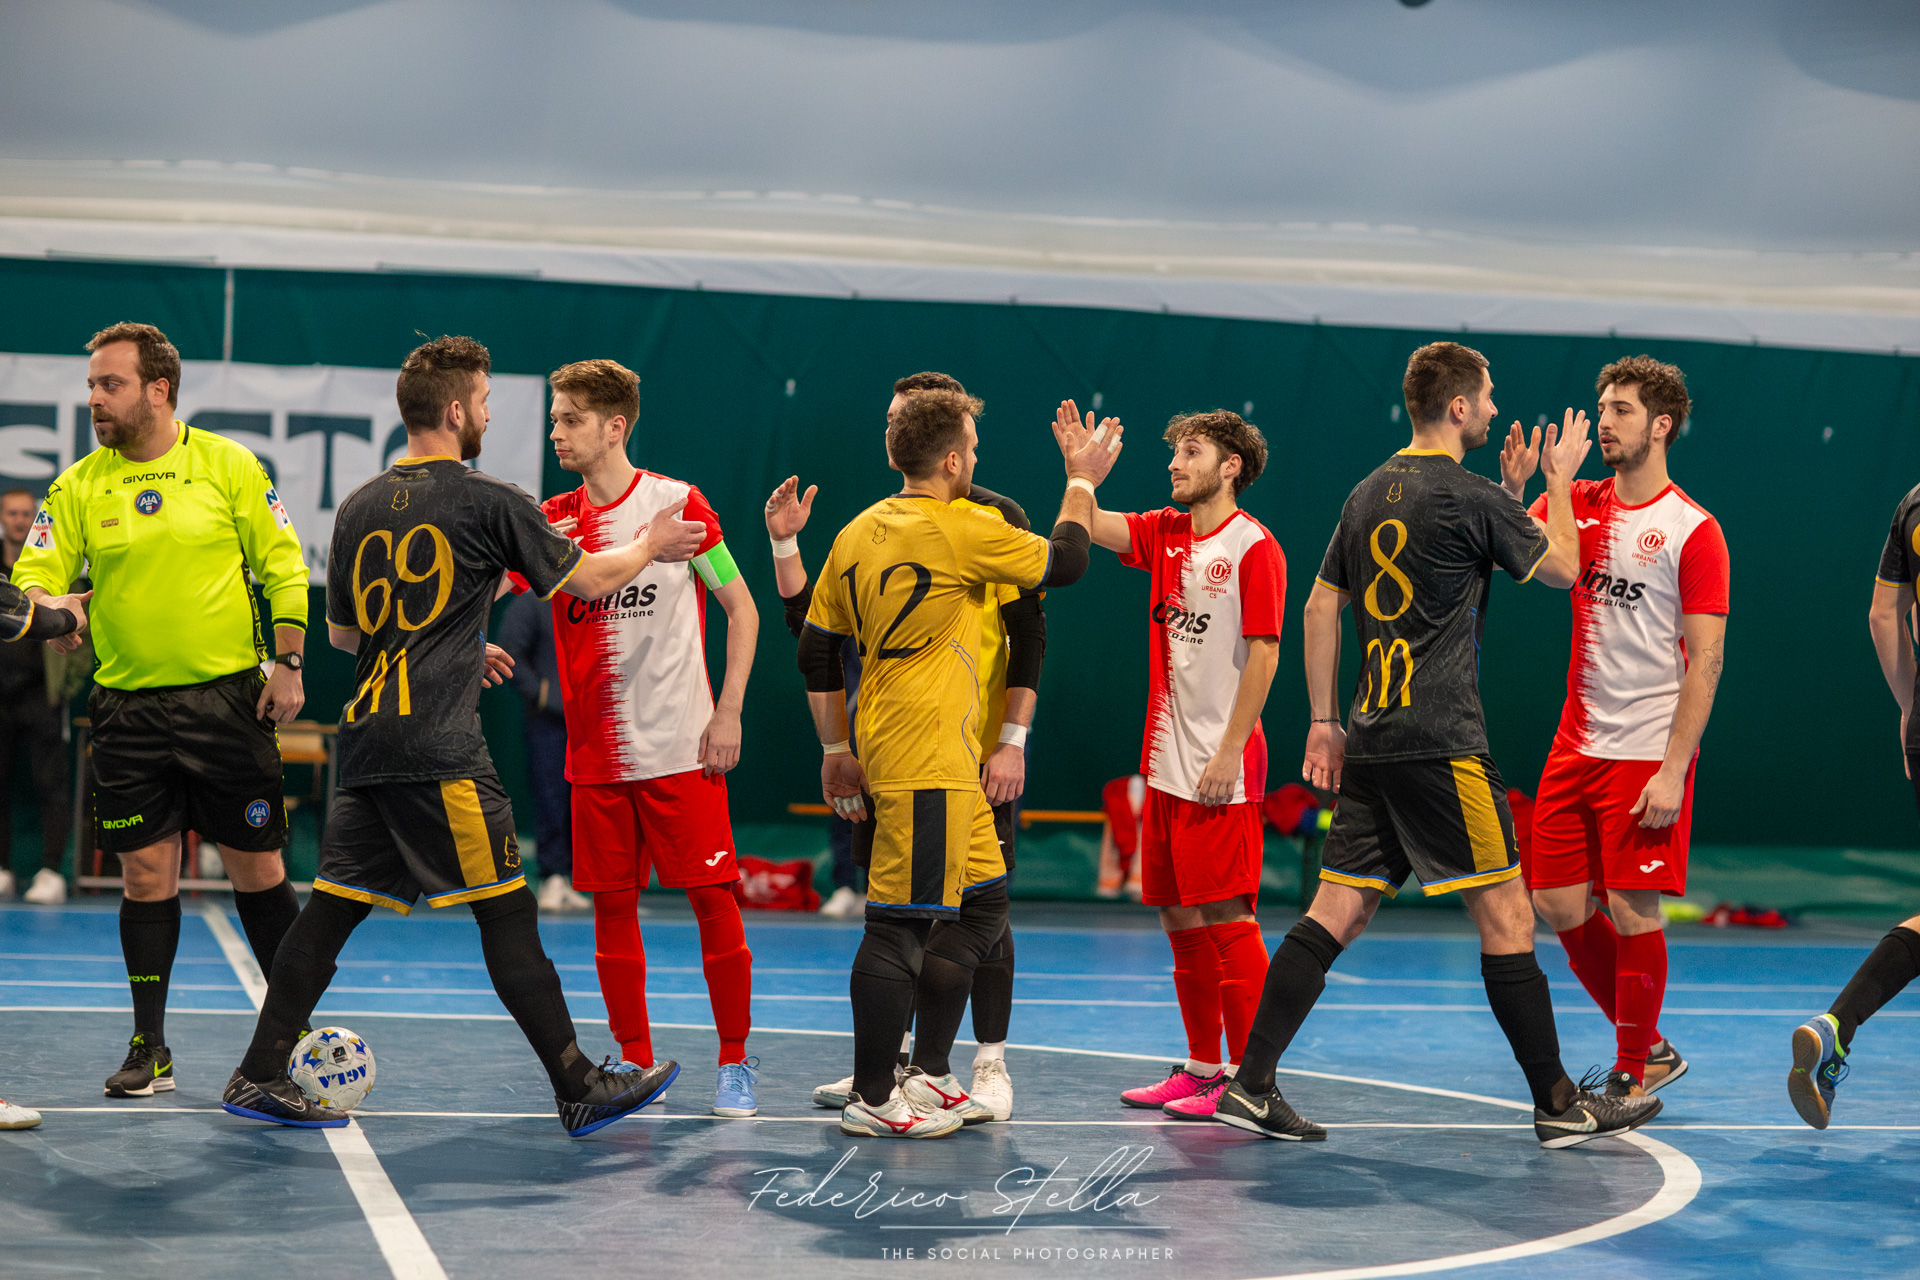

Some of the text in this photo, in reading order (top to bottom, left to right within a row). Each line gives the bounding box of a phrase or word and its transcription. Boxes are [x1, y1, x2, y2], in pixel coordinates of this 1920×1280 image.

[123, 472, 175, 484] GIVOVA
[1364, 519, 1414, 621] 8
[1632, 552, 1657, 564] URBANIA
[352, 523, 455, 635] 69
[1201, 585, 1227, 594] URBANIA
[1571, 560, 1646, 601] imas
[840, 561, 932, 660] 12
[1573, 590, 1638, 612] ristorazione
[318, 1064, 366, 1088] AGLA
